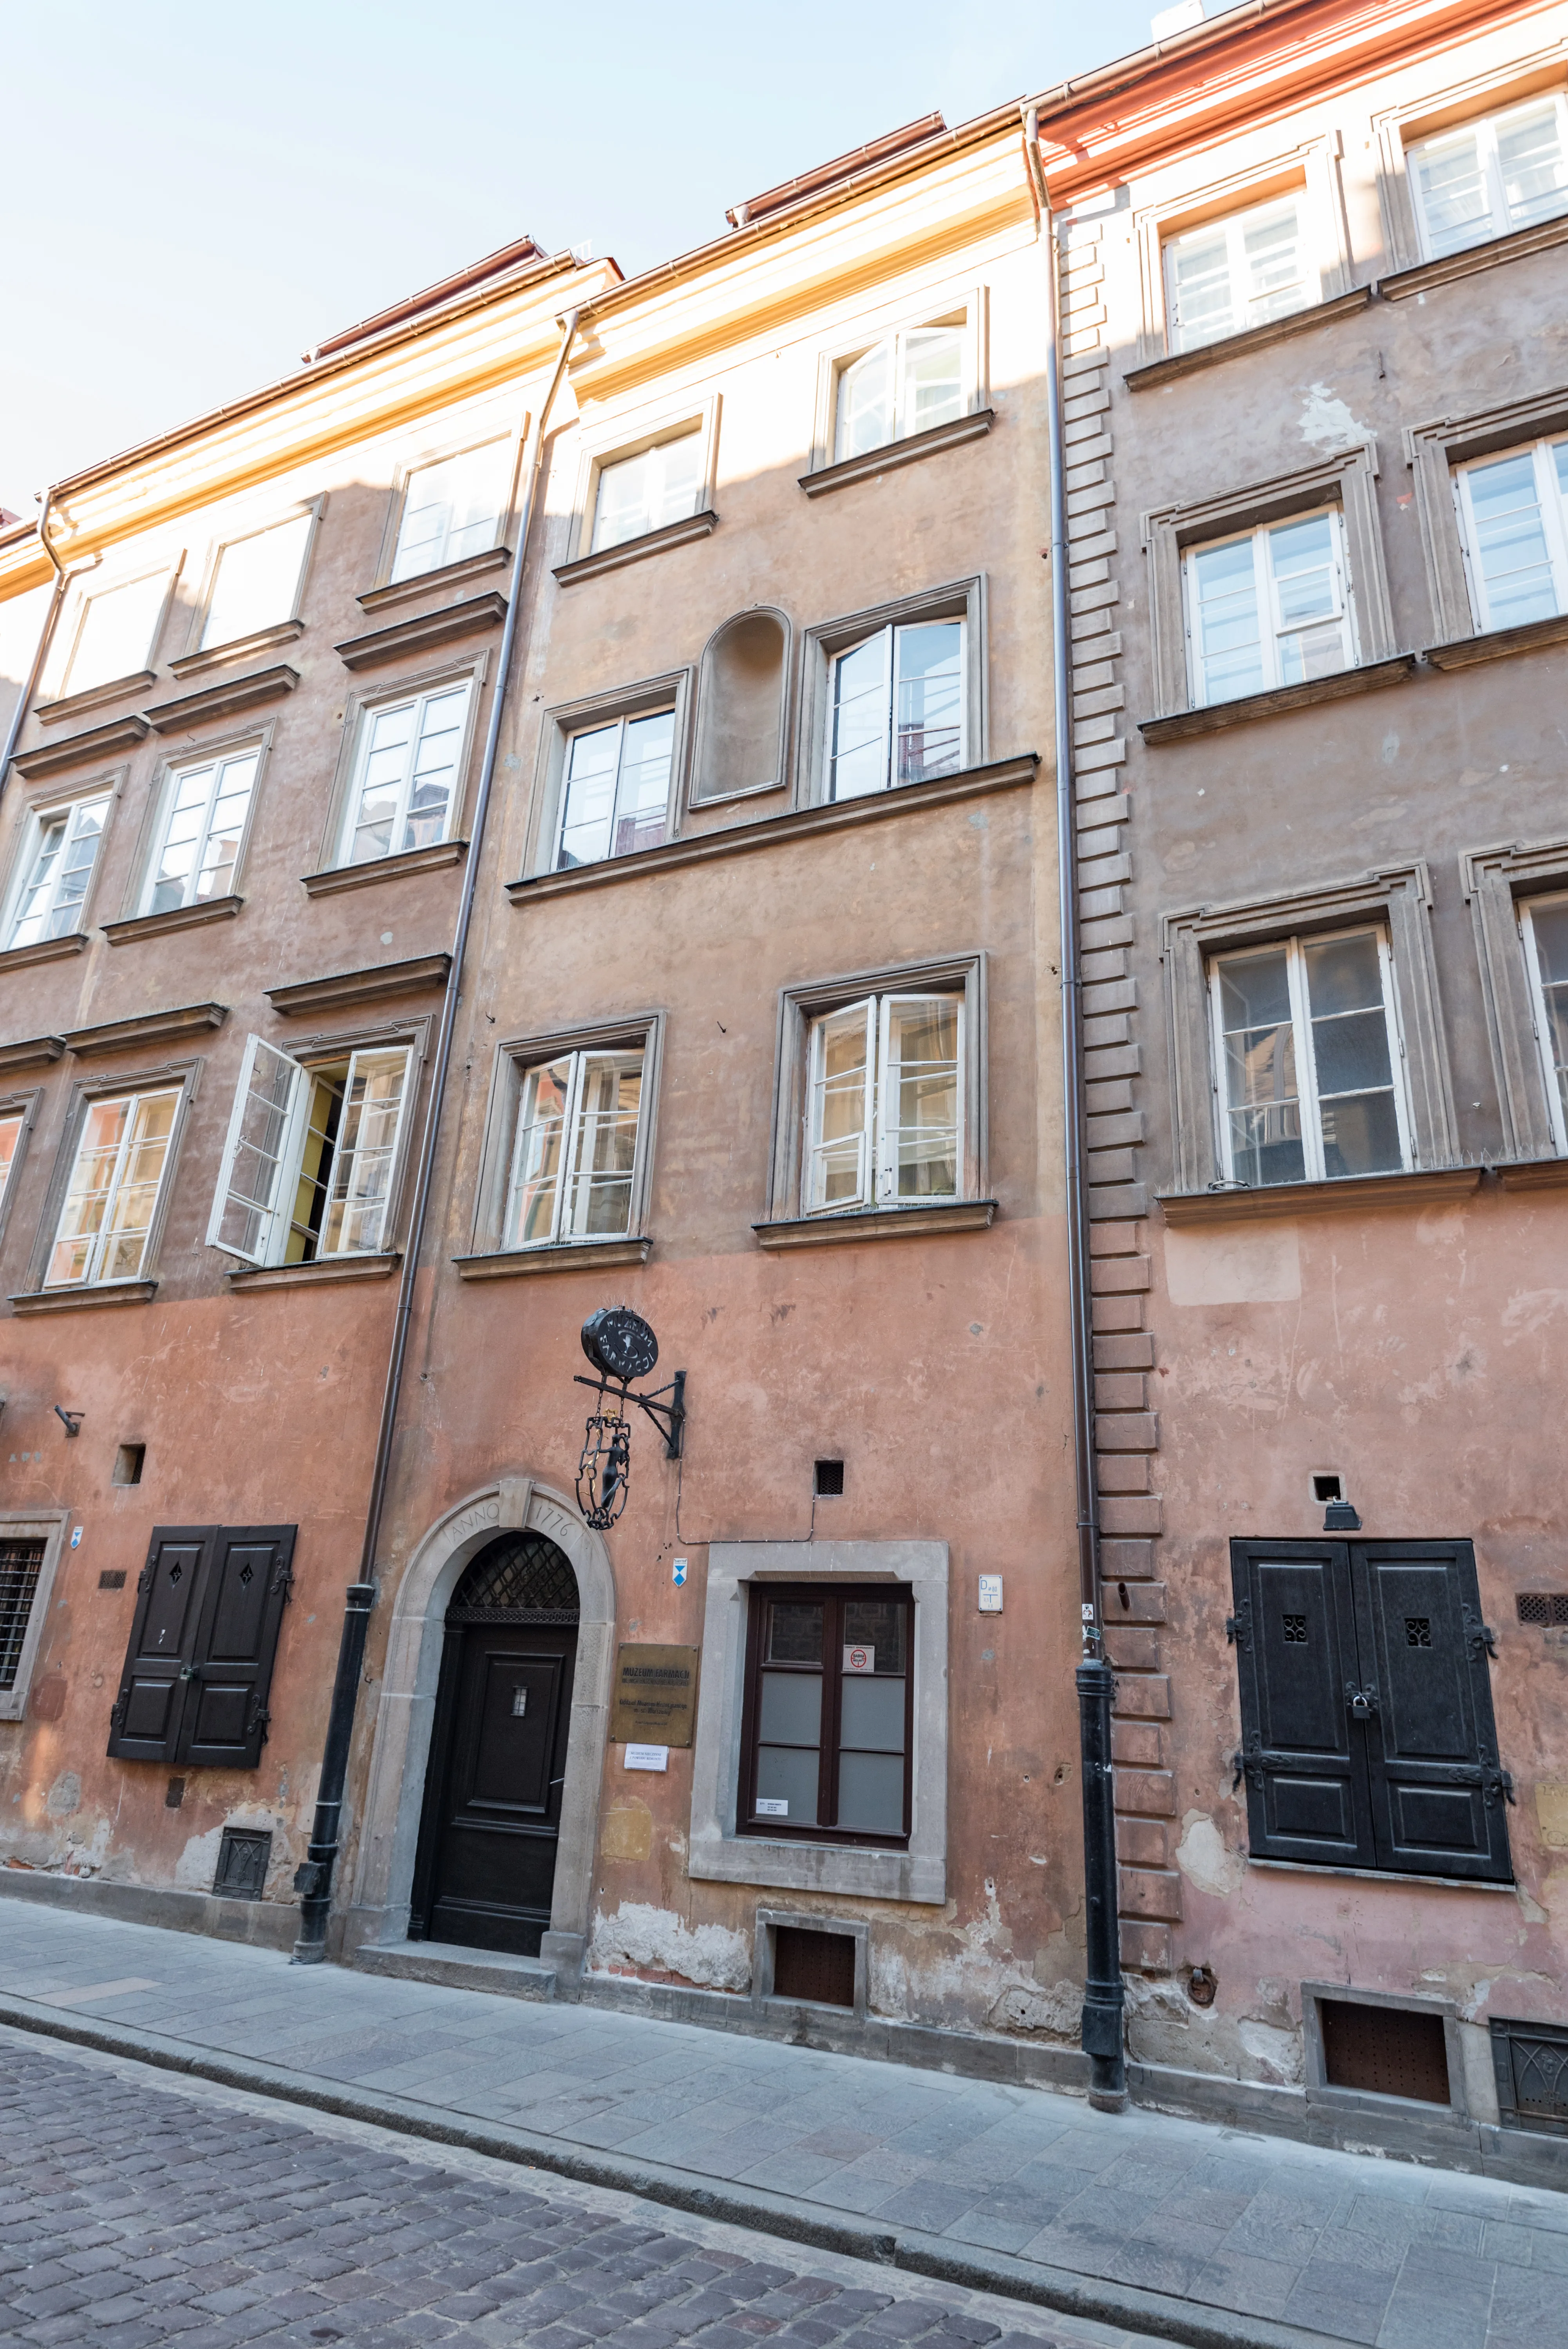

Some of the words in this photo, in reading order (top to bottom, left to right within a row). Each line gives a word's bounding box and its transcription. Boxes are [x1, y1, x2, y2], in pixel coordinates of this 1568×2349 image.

[607, 1315, 655, 1348] MUZEUM
[600, 1334, 654, 1372] FARMACJI
[453, 1503, 499, 1541] ANNO
[536, 1505, 575, 1536] 1776
[981, 1580, 987, 1589] D
[623, 1667, 653, 1677] MUZEUM
[656, 1669, 689, 1679] FARMACJI
[648, 1708, 671, 1716] Warszawy
